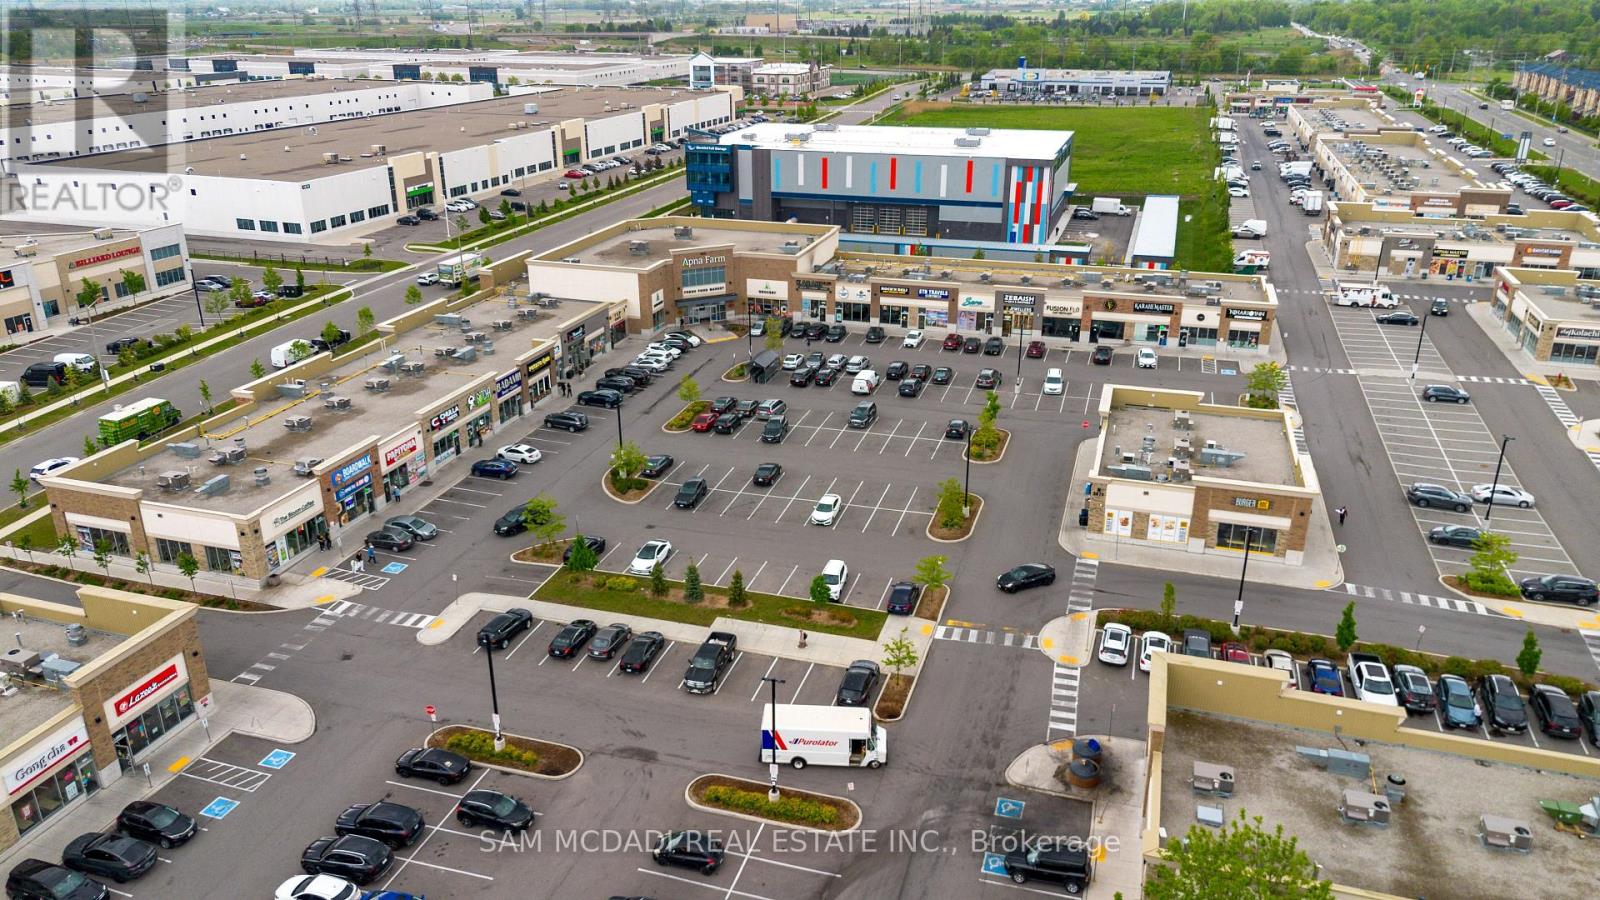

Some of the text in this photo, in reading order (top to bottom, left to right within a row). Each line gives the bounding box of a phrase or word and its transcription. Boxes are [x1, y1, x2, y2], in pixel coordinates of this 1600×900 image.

[75, 246, 141, 268] BILLIARD LOUNGE
[682, 255, 726, 267] Apna Farm
[1153, 303, 1173, 311] MASTER
[342, 454, 372, 479] BOARDWALK
[798, 738, 838, 747] Purolator
[15, 756, 47, 781] Gong
